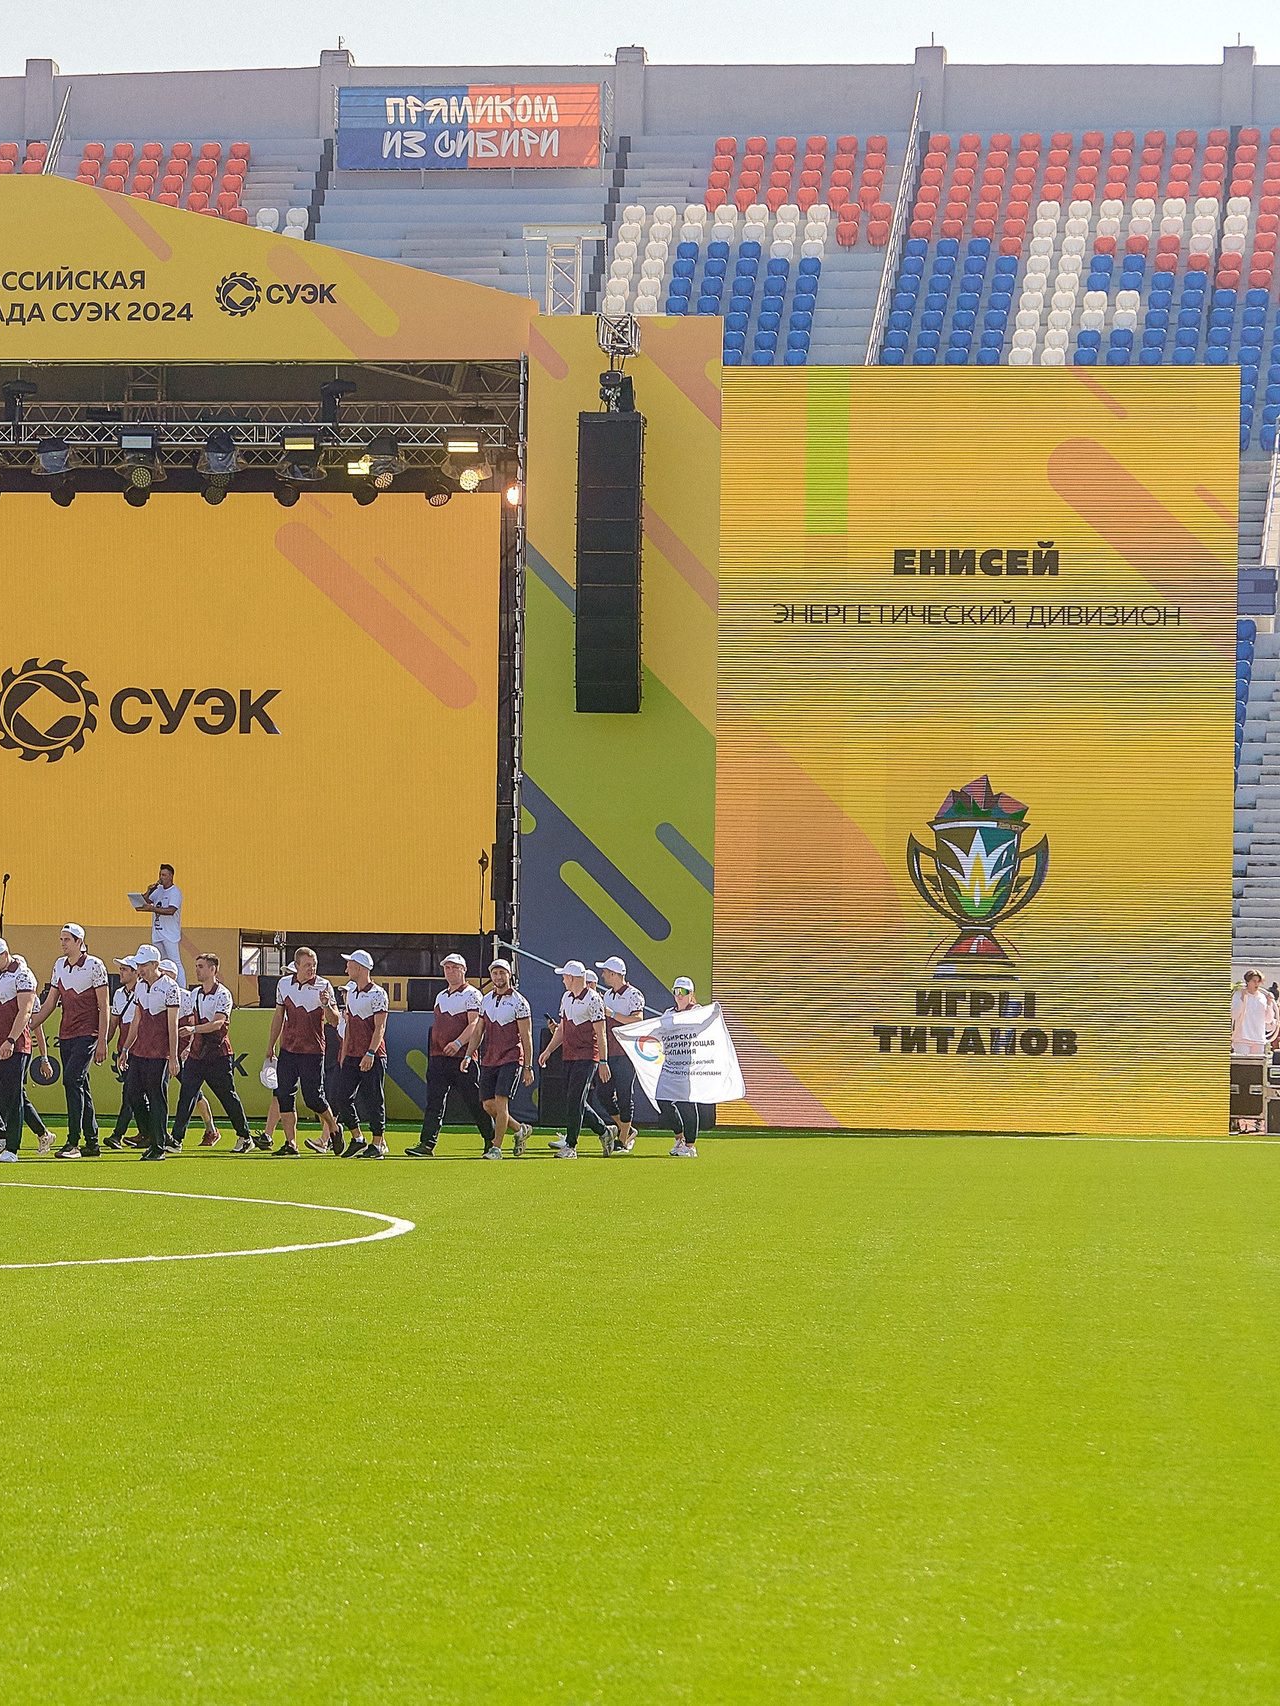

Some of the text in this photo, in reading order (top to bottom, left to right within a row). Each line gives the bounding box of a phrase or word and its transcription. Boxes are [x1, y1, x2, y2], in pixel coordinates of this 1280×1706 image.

[385, 95, 559, 125] ПРЯМИКОМ
[382, 128, 559, 159] ИЗ СИБИРИ
[266, 283, 337, 305] СУЭК
[52, 301, 122, 323] СУЭК
[126, 301, 194, 322] 2024
[893, 540, 1060, 576] ЕНИСЕЙ
[773, 599, 1181, 629] ЭНЕРГЕТИЧЕСКИЙ ДИВИЗИОН
[109, 686, 282, 736] СУЭК
[915, 989, 1036, 1018] ИГРЫ
[872, 1025, 1079, 1056] ТИТАНОВ
